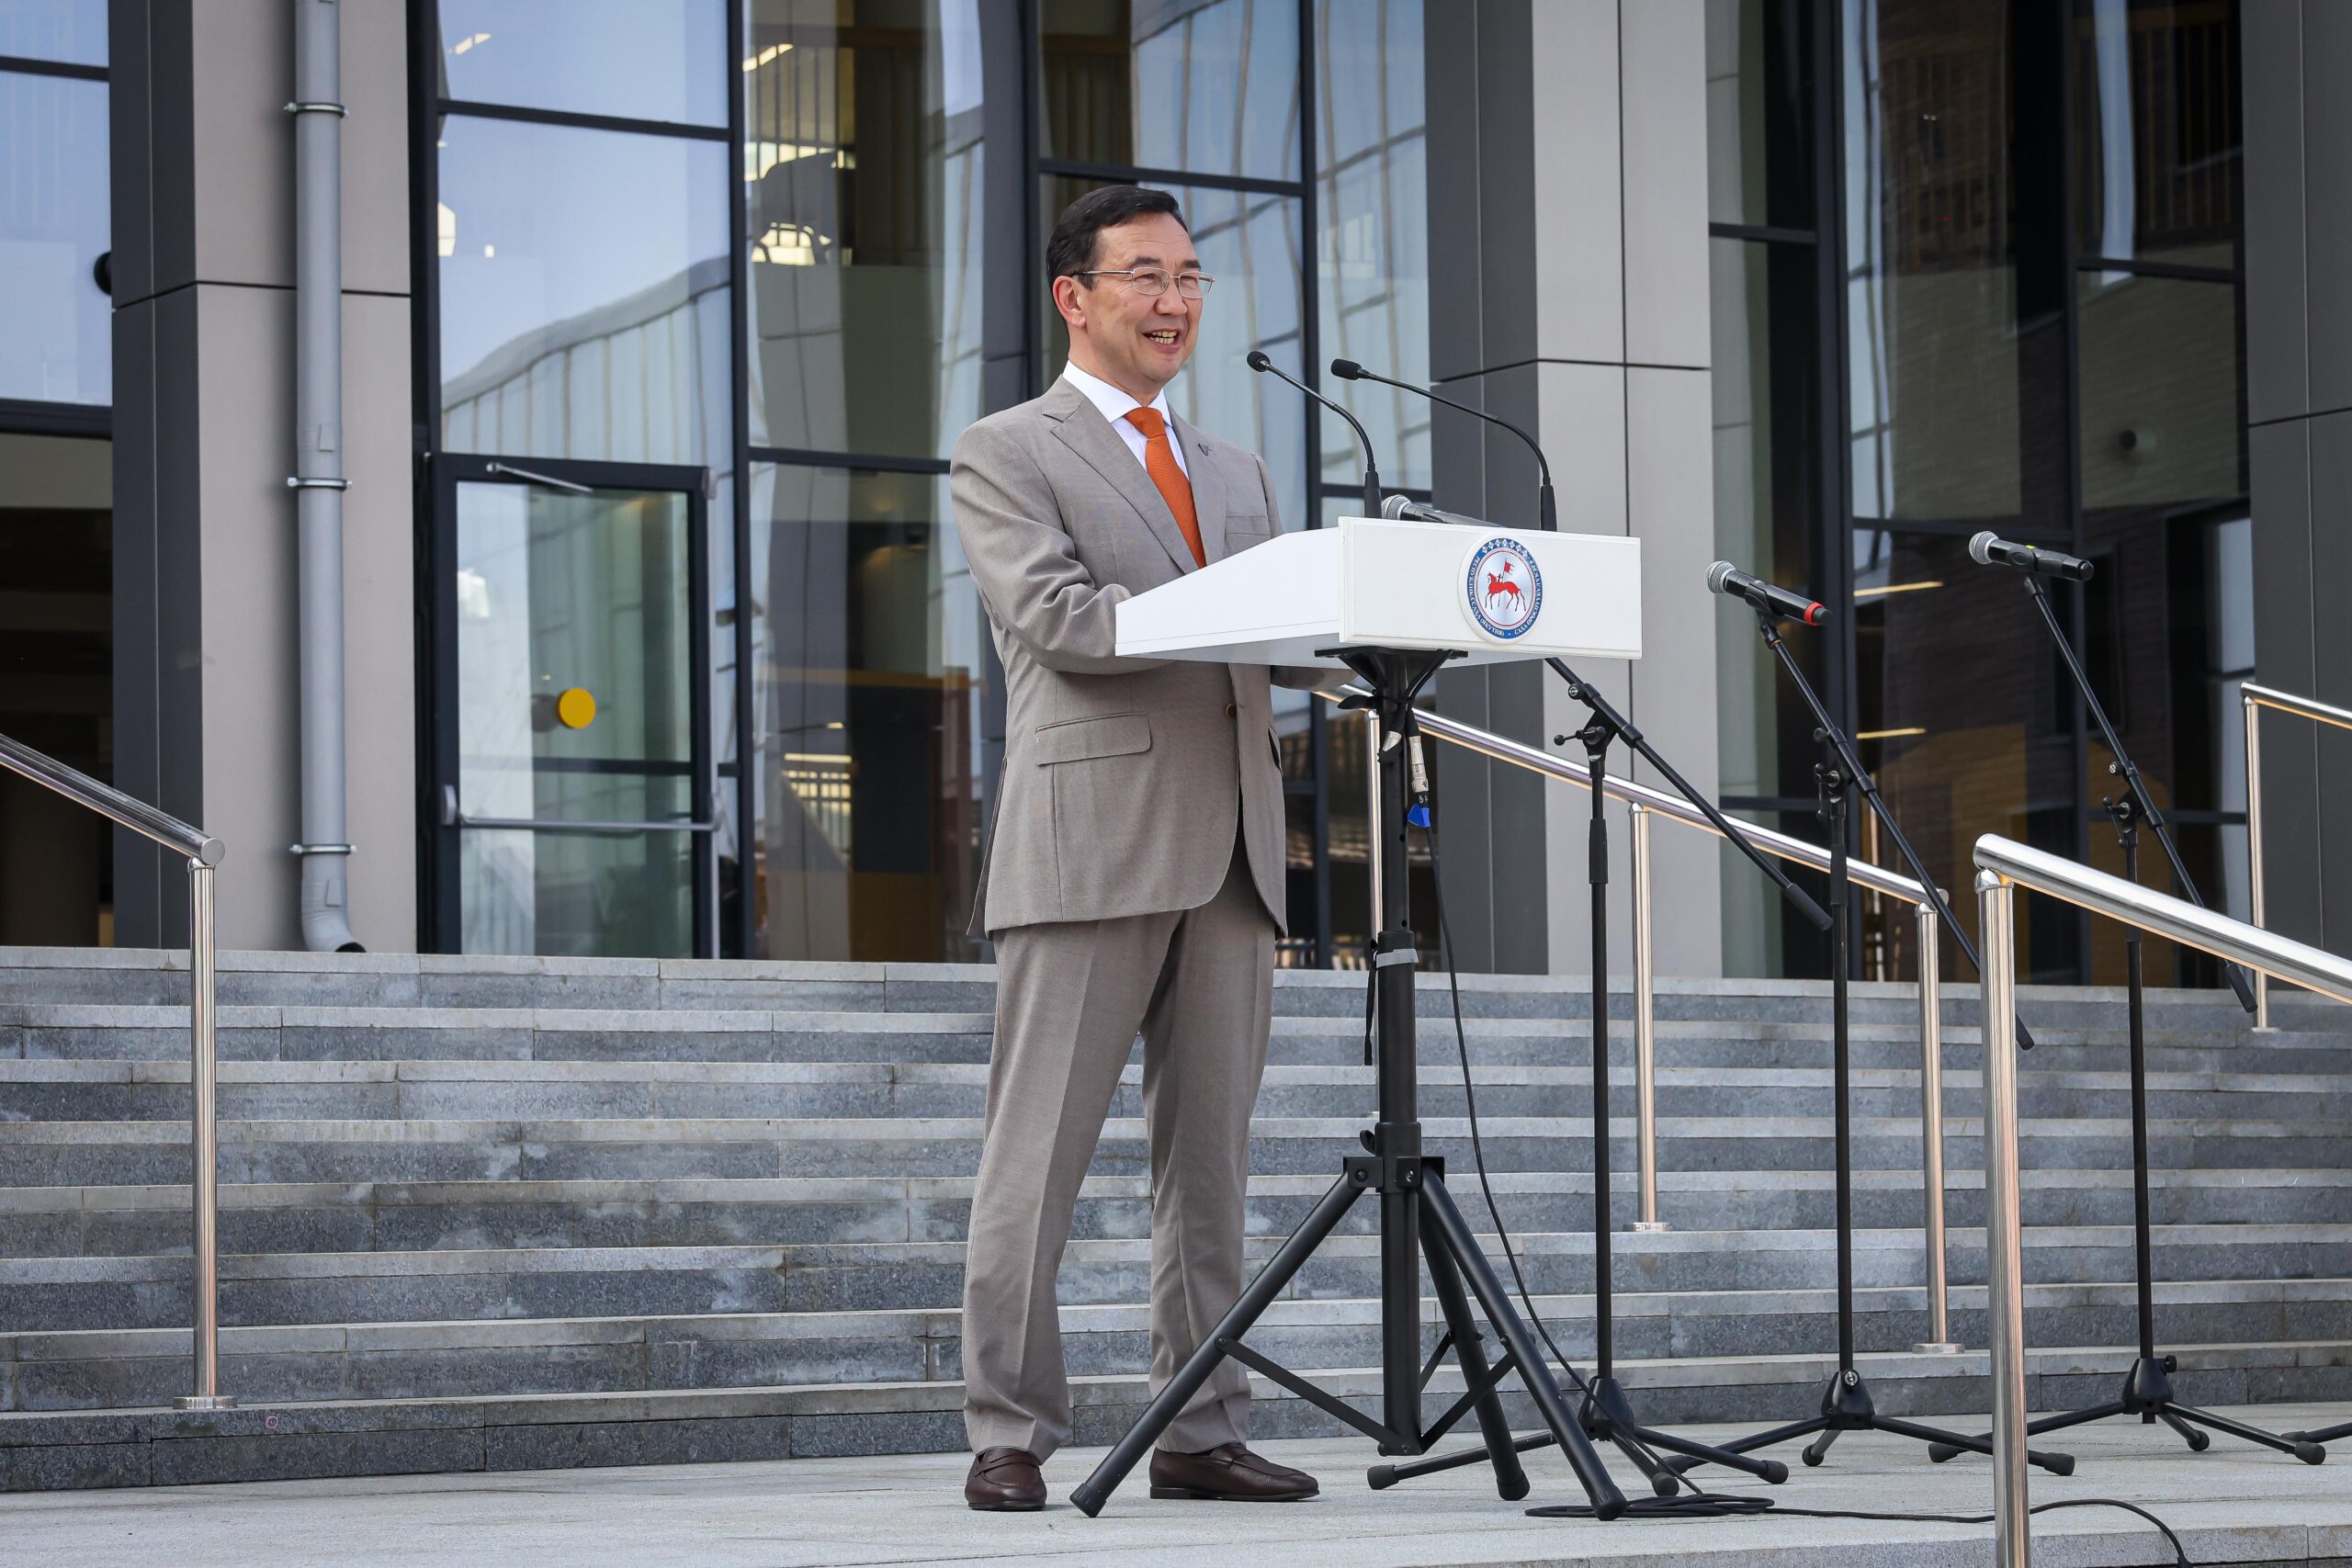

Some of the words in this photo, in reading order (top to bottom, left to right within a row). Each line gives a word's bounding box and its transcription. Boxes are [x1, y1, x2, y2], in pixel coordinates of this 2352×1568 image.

[1471, 600, 1482, 622] САХА
[1480, 617, 1505, 637] (ЯКУТИЯ)
[1514, 624, 1528, 635] САХА
